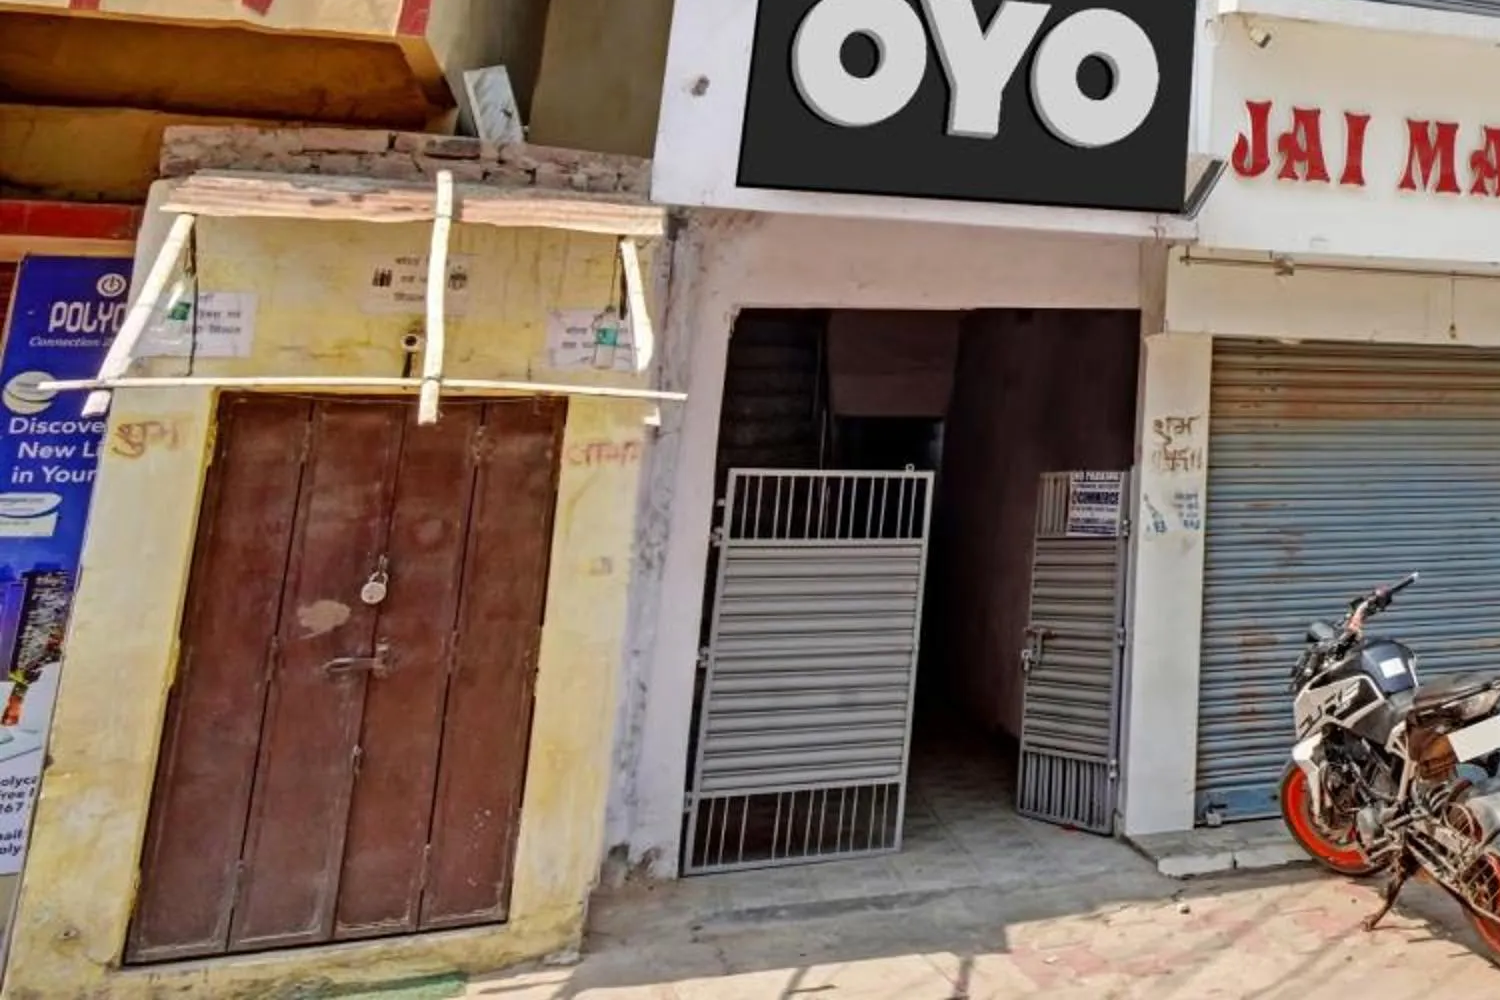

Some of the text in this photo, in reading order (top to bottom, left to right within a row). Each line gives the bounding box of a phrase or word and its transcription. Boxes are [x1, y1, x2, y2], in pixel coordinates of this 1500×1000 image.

[1231, 99, 1371, 187] JAI
[18, 441, 76, 460] New
[11, 466, 34, 484] in
